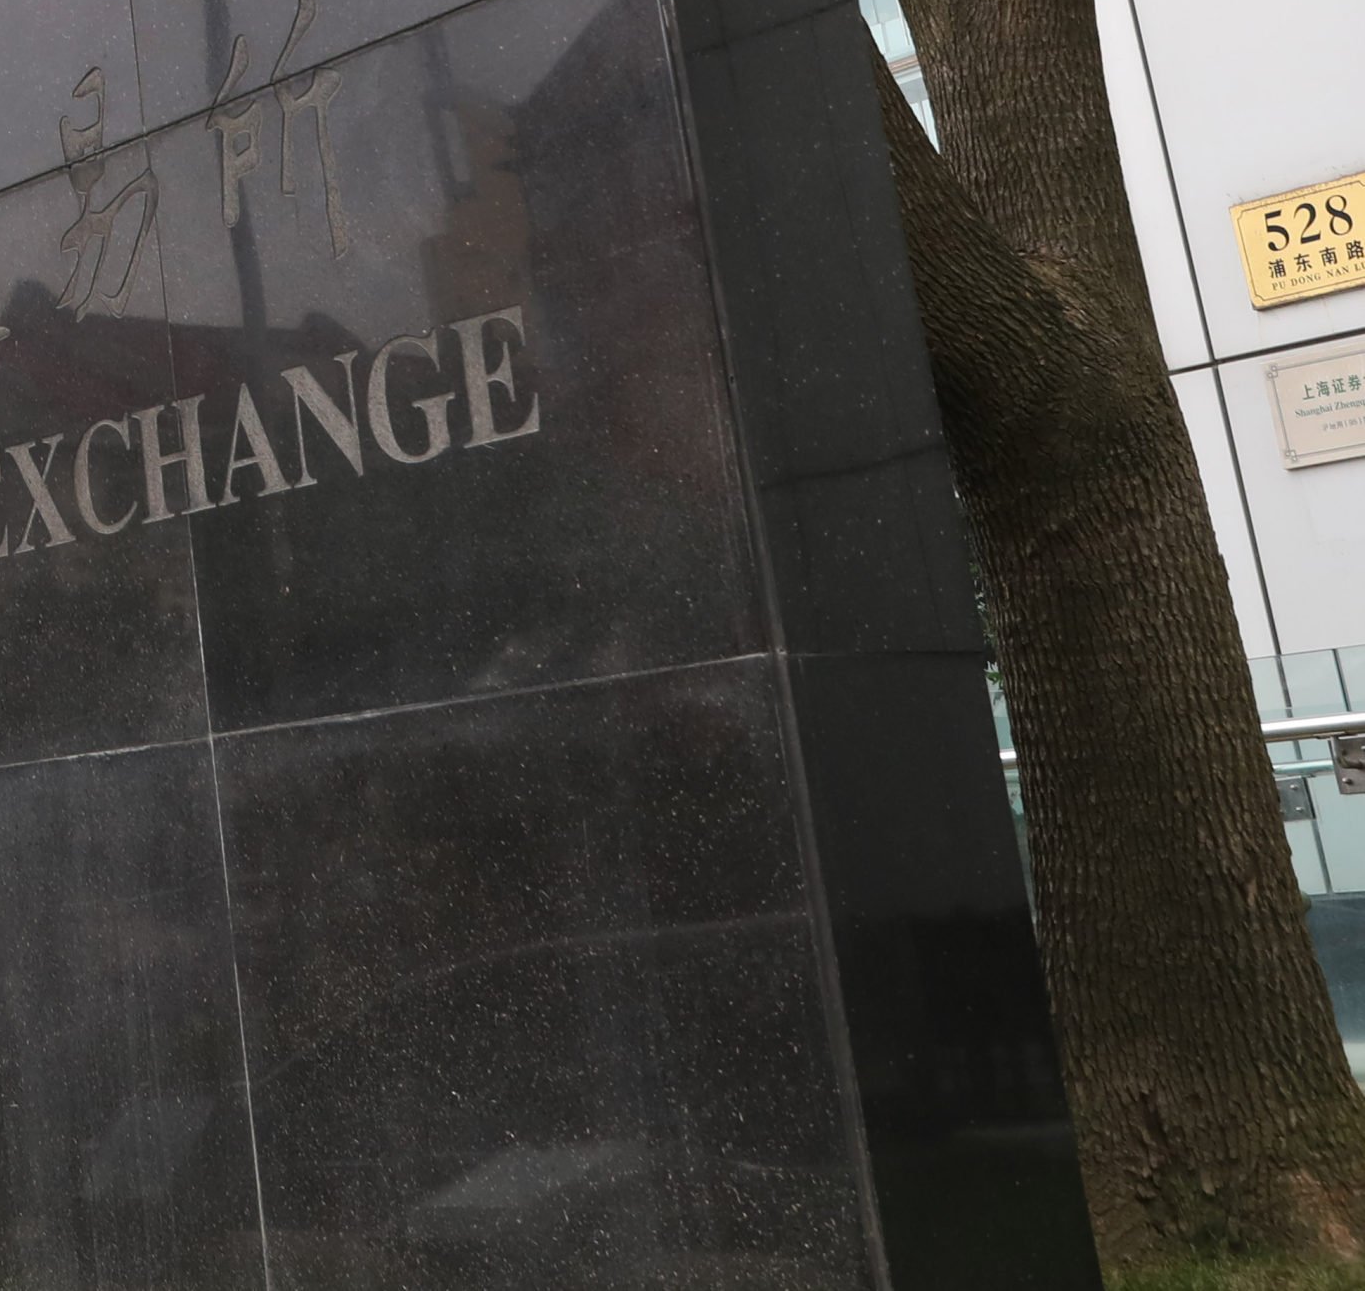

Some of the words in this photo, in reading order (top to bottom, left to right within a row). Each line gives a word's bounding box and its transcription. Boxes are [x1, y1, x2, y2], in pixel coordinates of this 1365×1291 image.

[1265, 195, 1353, 252] 528
[1268, 240, 1365, 279] 浦东南路
[1271, 281, 1287, 291] PU
[1290, 273, 1321, 287] DONG
[1326, 265, 1350, 278] NAN
[1302, 374, 1365, 401] 上海证券
